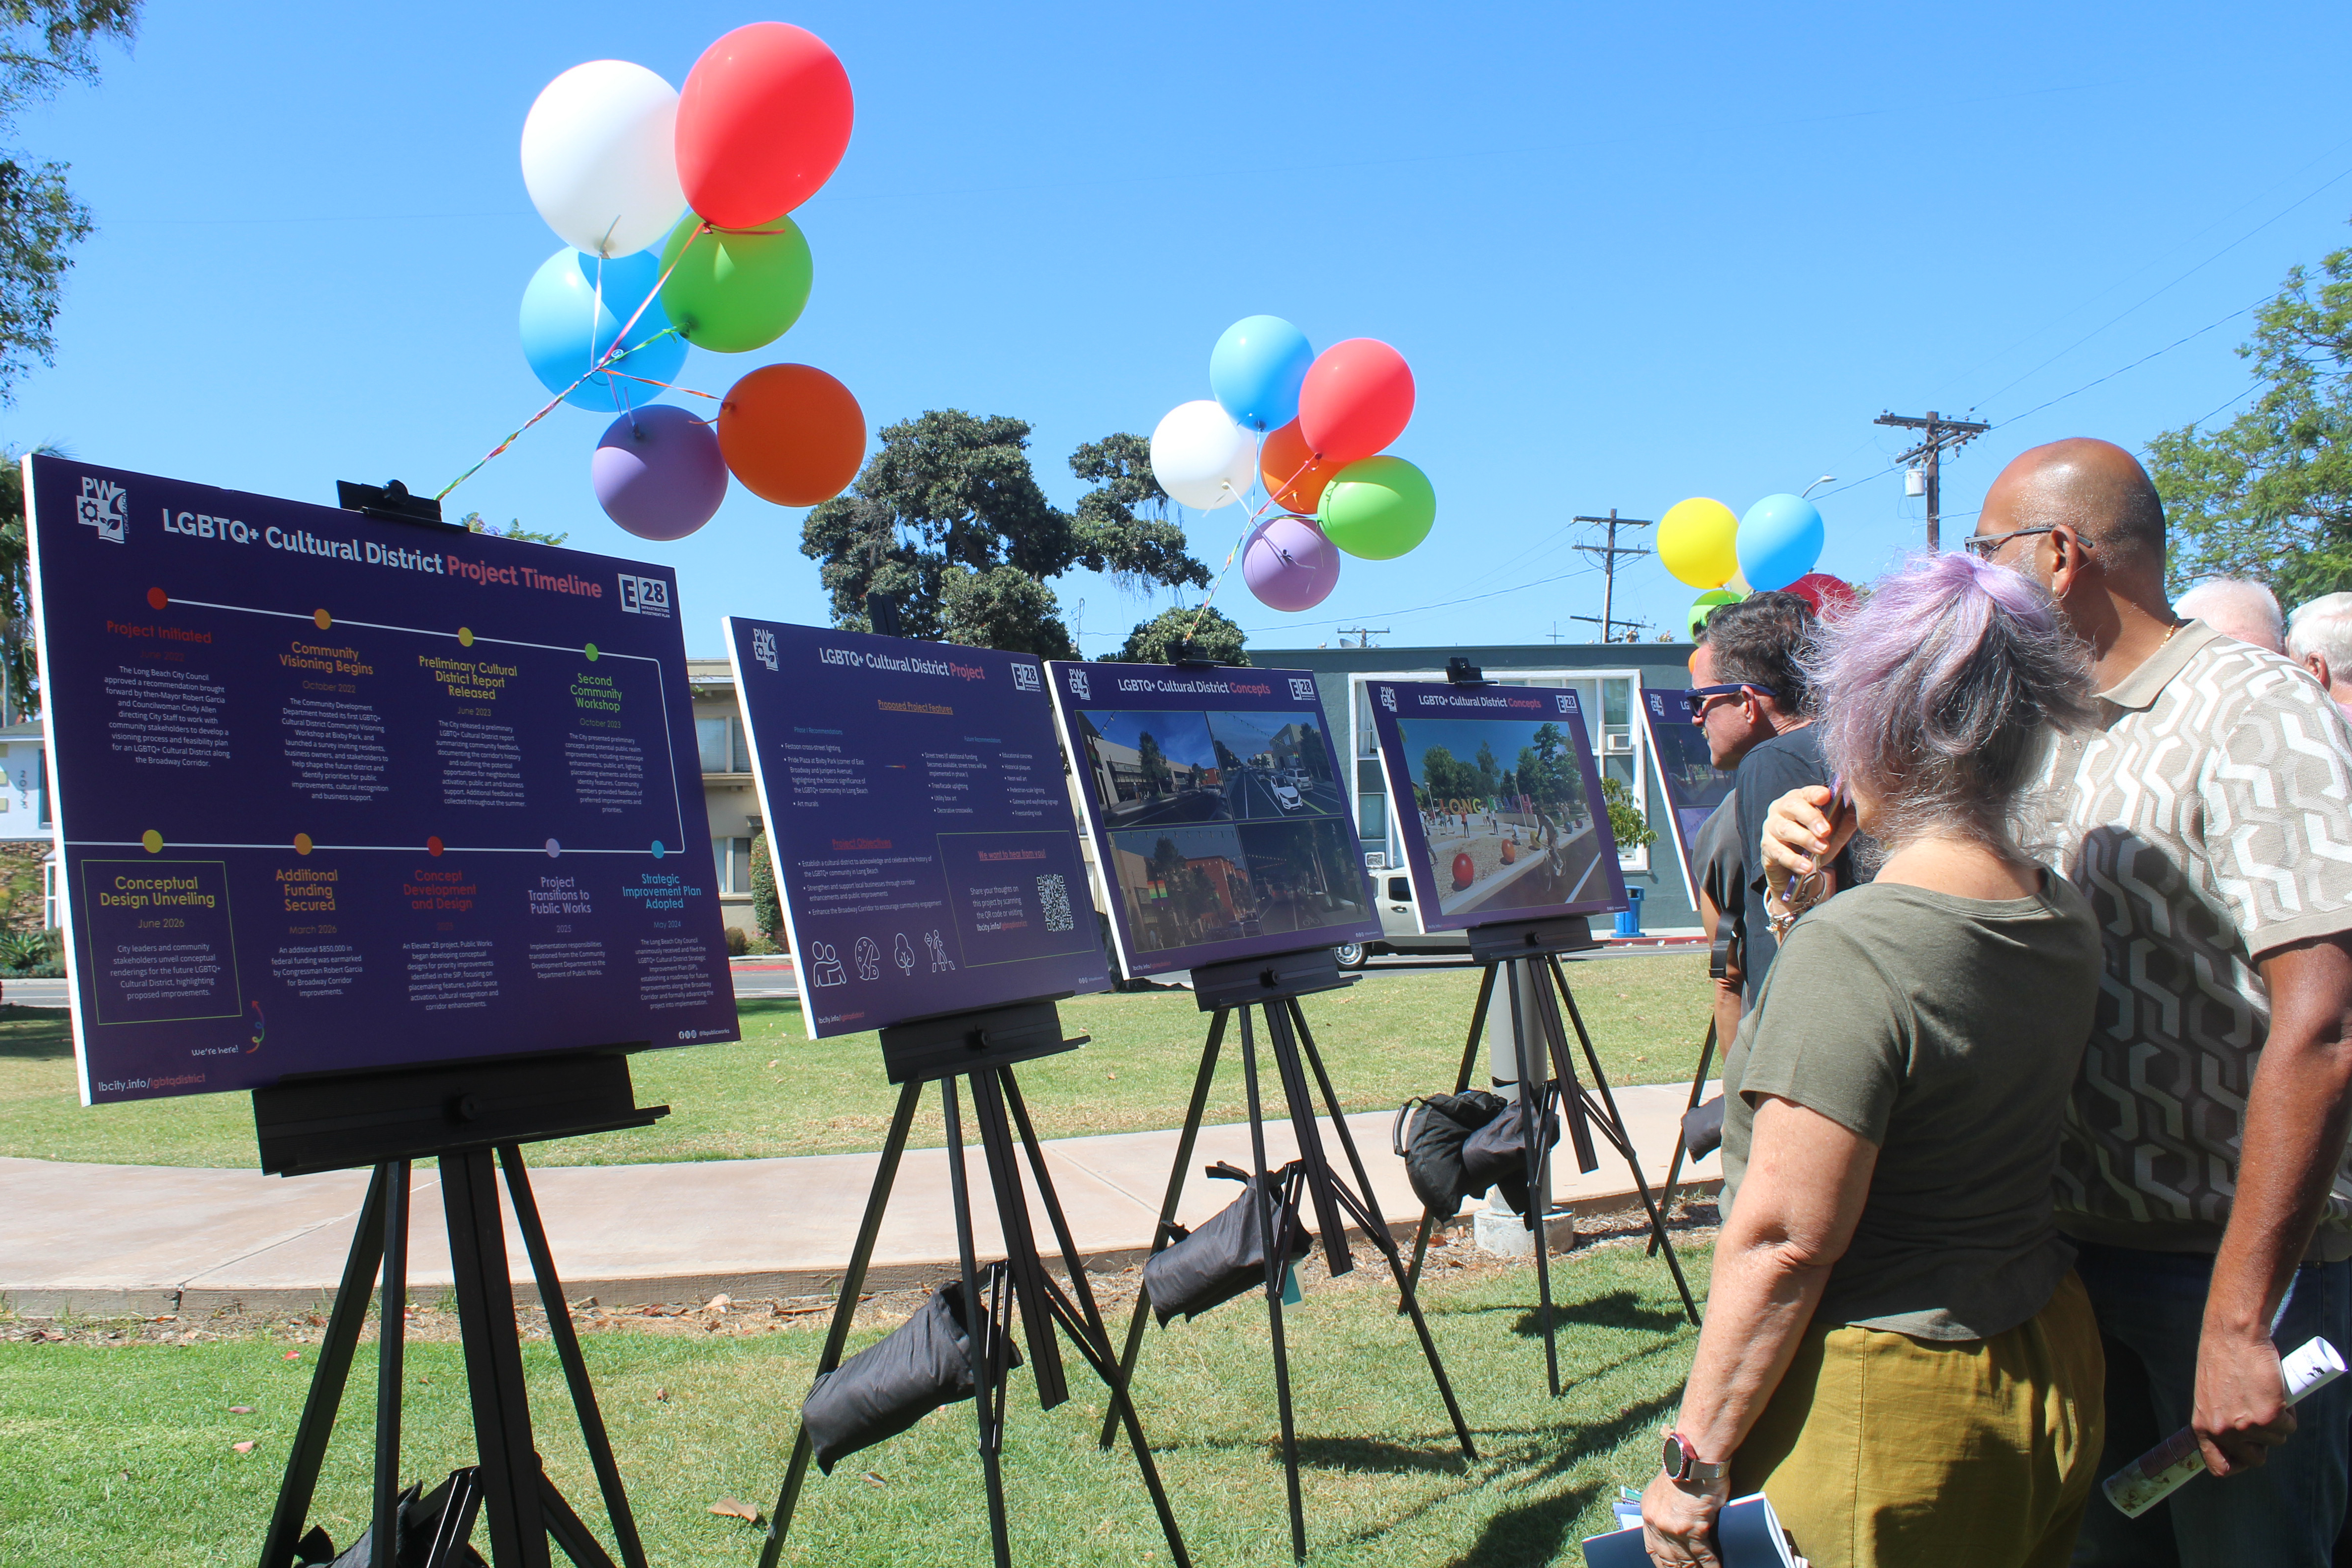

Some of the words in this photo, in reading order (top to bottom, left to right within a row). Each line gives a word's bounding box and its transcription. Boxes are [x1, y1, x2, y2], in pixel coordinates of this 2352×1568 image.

[82, 476, 115, 500] PW
[163, 508, 259, 544] LGBTQ+
[266, 527, 362, 561] Cultural
[365, 542, 444, 574] District
[447, 555, 518, 585] Project
[520, 567, 602, 597] Timeline
[622, 579, 637, 608] E
[642, 581, 665, 603] 28
[107, 621, 154, 638] Project
[158, 627, 212, 643] Initiated
[291, 641, 360, 662] Community
[279, 654, 333, 673] Visioning
[336, 660, 373, 676] Begins
[419, 656, 477, 674] Preliminary
[479, 662, 517, 680] Cultural
[819, 648, 863, 667] LGBTQ+
[866, 653, 911, 672] Cultural
[911, 658, 949, 675] District
[949, 663, 985, 681] Project
[133, 668, 150, 677] Long
[173, 672, 184, 680] City
[578, 673, 612, 686] Second
[1024, 667, 1036, 681] 28
[143, 681, 198, 690] recommendation
[200, 684, 224, 694] brought
[303, 680, 337, 691] October
[338, 684, 355, 693] 2022
[435, 671, 469, 684] District
[472, 673, 504, 691] Report
[1118, 679, 1155, 691] LGBTQ+
[1157, 680, 1197, 692] Cultural
[1196, 681, 1230, 693] District
[1230, 682, 1270, 696] Concepts
[1300, 681, 1311, 692] 28
[106, 687, 133, 695] forward
[134, 690, 142, 698] by
[143, 691, 181, 701] then-Mayor
[448, 685, 495, 699] Released
[571, 684, 622, 701] Community
[576, 697, 620, 713] Workshop
[878, 700, 908, 711] Proposed
[907, 702, 930, 713] Project
[929, 704, 953, 714] Features
[1419, 695, 1448, 705] LGBTQ+
[1450, 696, 1481, 706] Cultural
[1480, 697, 1508, 707] District
[1509, 698, 1541, 710] Concepts
[1565, 697, 1575, 706] 28
[580, 718, 606, 727] October
[275, 869, 338, 881] Additional
[414, 870, 462, 883] Concept
[642, 874, 679, 886] Strategic
[115, 876, 198, 894] Conceptual
[403, 884, 477, 897] Development
[541, 877, 574, 891] Project
[284, 884, 334, 900] Funding
[528, 889, 577, 900] Transitions
[579, 890, 589, 900] to
[622, 885, 681, 898] Improvement
[683, 886, 701, 896] Plan
[100, 893, 148, 909] Design
[153, 892, 215, 908] Unveiling
[285, 898, 335, 911] Secured
[411, 898, 433, 909] and
[437, 898, 473, 911] Design
[646, 898, 683, 911] Adopted
[531, 903, 560, 914] Public
[563, 902, 591, 913] Works
[138, 920, 160, 928] June
[163, 918, 184, 928] 2026
[289, 926, 316, 934] March
[318, 925, 337, 934] 2026
[117, 945, 131, 954] City
[180, 954, 216, 963] conceptual
[110, 969, 147, 977] renderings
[176, 978, 215, 986] highlighting
[127, 991, 160, 1001] proposed
[161, 989, 211, 998] improvements.
[218, 1045, 238, 1054] here!
[98, 1074, 205, 1091] lbcity.info/lgbtqdistrict
